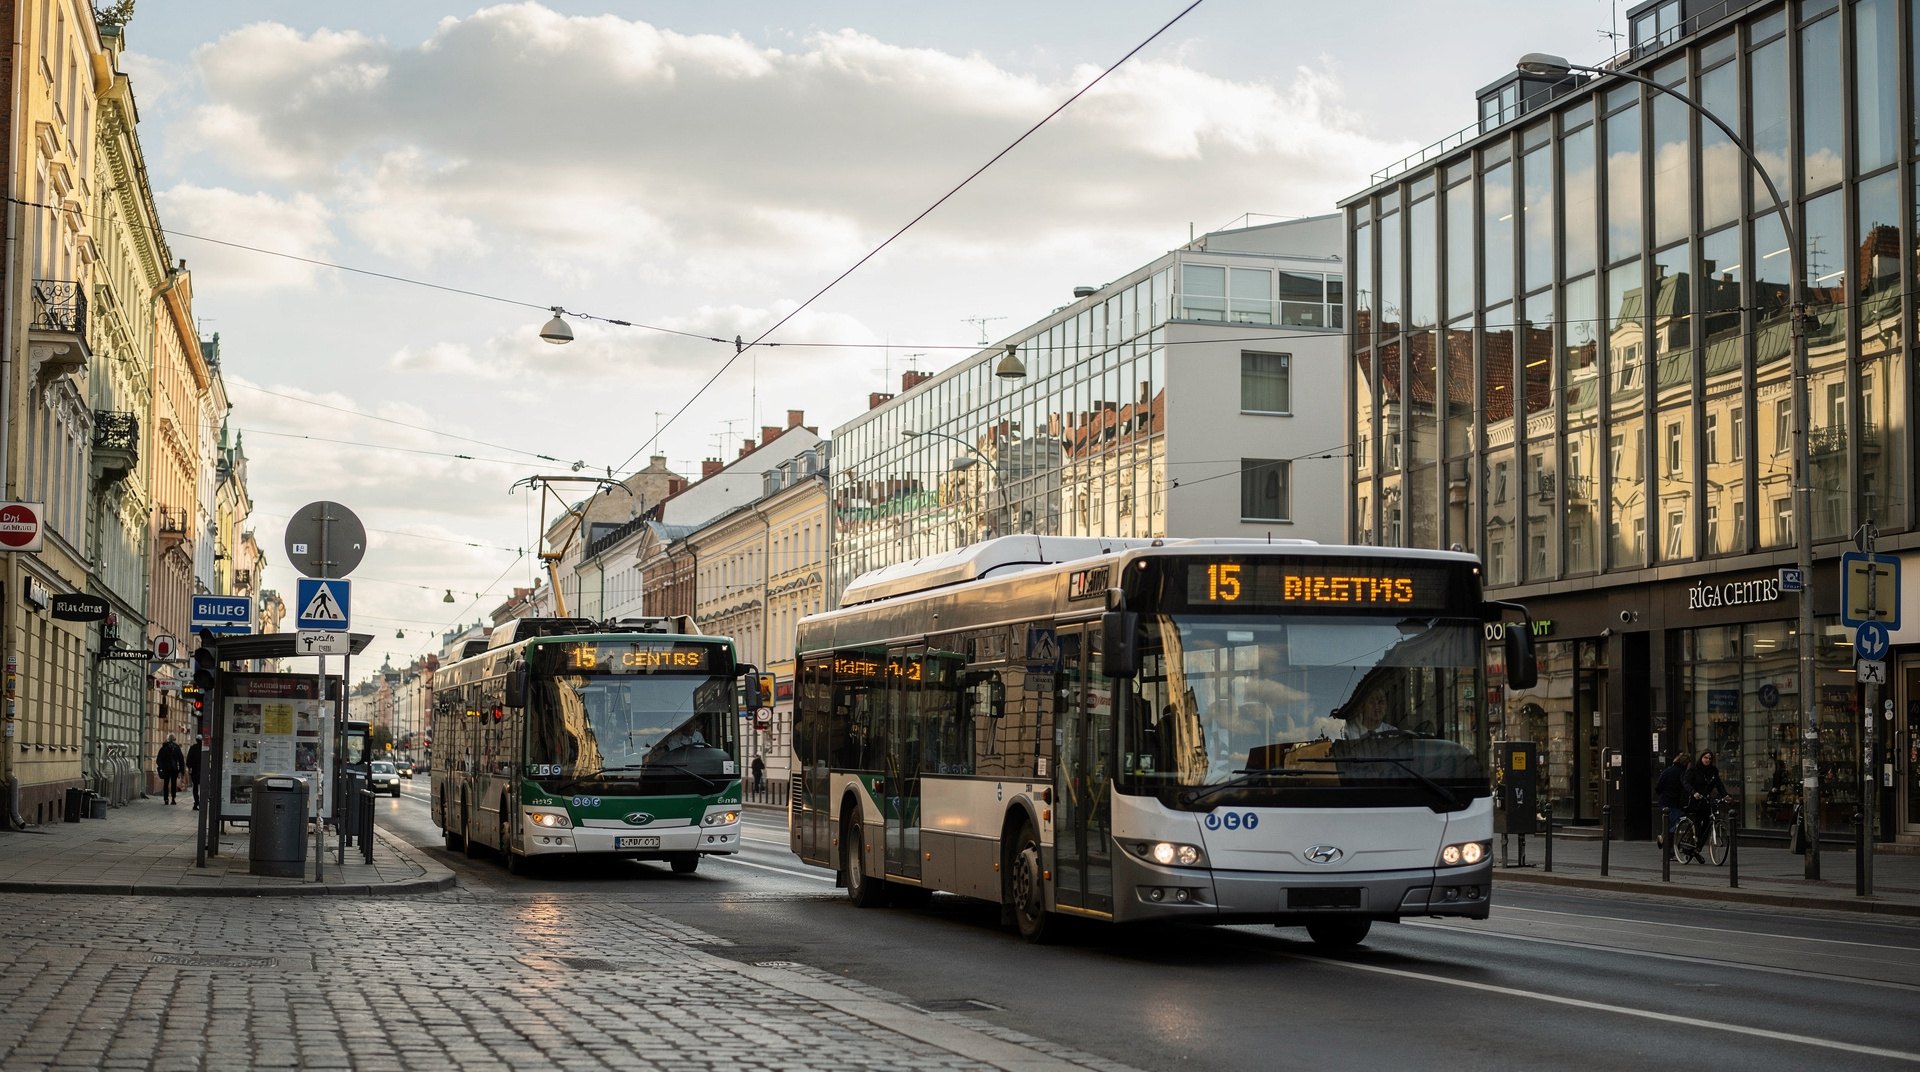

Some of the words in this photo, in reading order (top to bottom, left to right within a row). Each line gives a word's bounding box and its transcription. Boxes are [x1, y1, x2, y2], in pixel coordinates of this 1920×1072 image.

[1208, 564, 1240, 600] 15
[572, 647, 597, 667] 15
[622, 651, 700, 666] CENTRS
